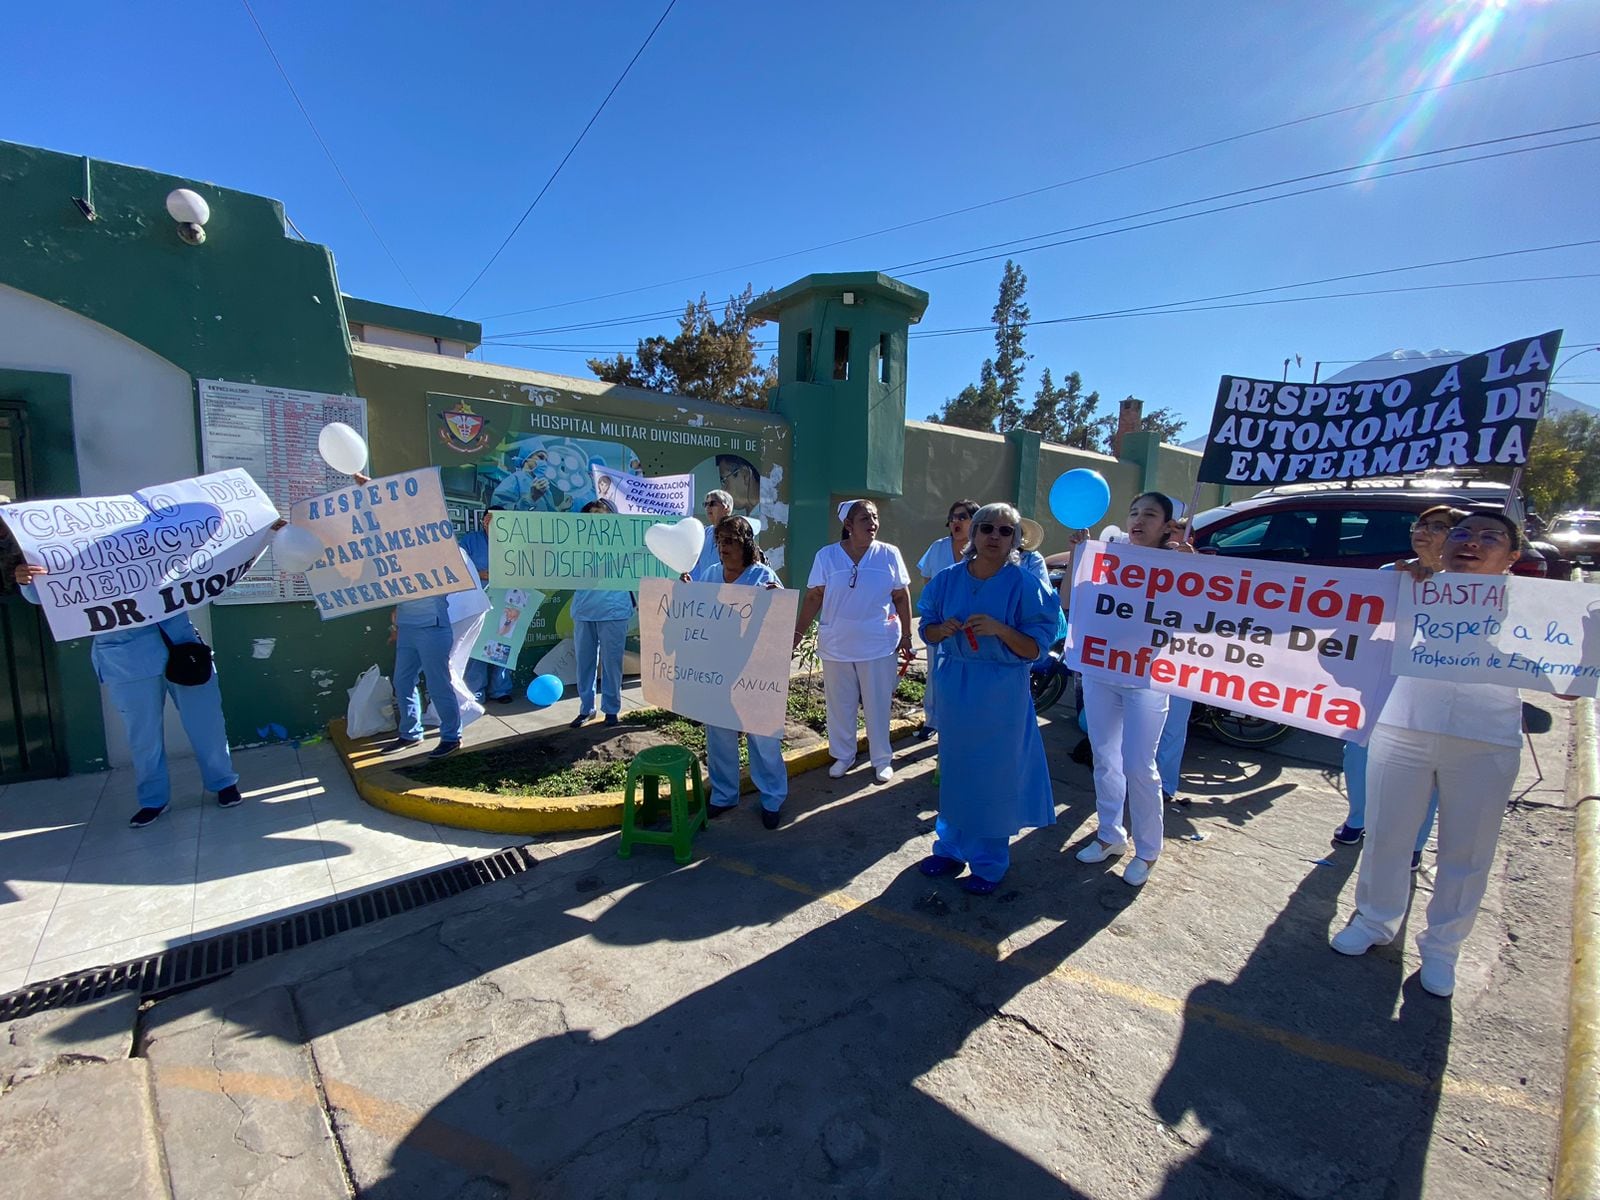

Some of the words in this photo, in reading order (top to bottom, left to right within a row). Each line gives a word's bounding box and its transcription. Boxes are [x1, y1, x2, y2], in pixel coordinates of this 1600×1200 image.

[1224, 378, 1412, 417] RESPETO
[1431, 365, 1461, 397] A
[1481, 339, 1550, 383] LA
[530, 413, 596, 434] HOSPITAL
[600, 422, 647, 441] MILITAR
[650, 429, 721, 449] DIVISIONARIO
[730, 438, 740, 450] III
[745, 439, 757, 452] DE
[1213, 397, 1465, 451] AUTONOMIA
[1481, 381, 1547, 423] DE
[1225, 425, 1526, 482] ENFERMERIA
[202, 478, 255, 504] DE
[309, 477, 419, 520] RESPETO
[625, 494, 685, 509] ENFERMERAS
[628, 503, 634, 512] Y
[631, 488, 645, 496] DE
[352, 511, 380, 534] AL
[496, 516, 570, 545] SALUD
[576, 518, 626, 547] PARA
[39, 510, 255, 575] DIRECTOR
[305, 519, 453, 571] PARTAMENTO
[373, 554, 402, 577] DE
[504, 550, 535, 577] SIN
[316, 565, 459, 611] ENFERMERIA
[1091, 552, 1385, 625] Reposición
[84, 598, 153, 632] DR.
[657, 593, 753, 621] AUMENTO
[684, 627, 709, 642] DEL
[1095, 593, 1134, 619] De
[1144, 602, 1182, 629] La
[1193, 611, 1272, 646] Jefa
[1288, 625, 1358, 660] Del
[1413, 613, 1501, 643] Respeto
[1513, 625, 1532, 641] a
[1544, 620, 1573, 646] la
[1151, 629, 1214, 658] Dpto
[1224, 643, 1265, 668] De
[1410, 646, 1480, 668] Profesión
[1486, 653, 1503, 669] de
[652, 652, 724, 686] PRESUPUESTO
[733, 677, 782, 693] ANUAL
[1080, 635, 1364, 730] Enfermería
